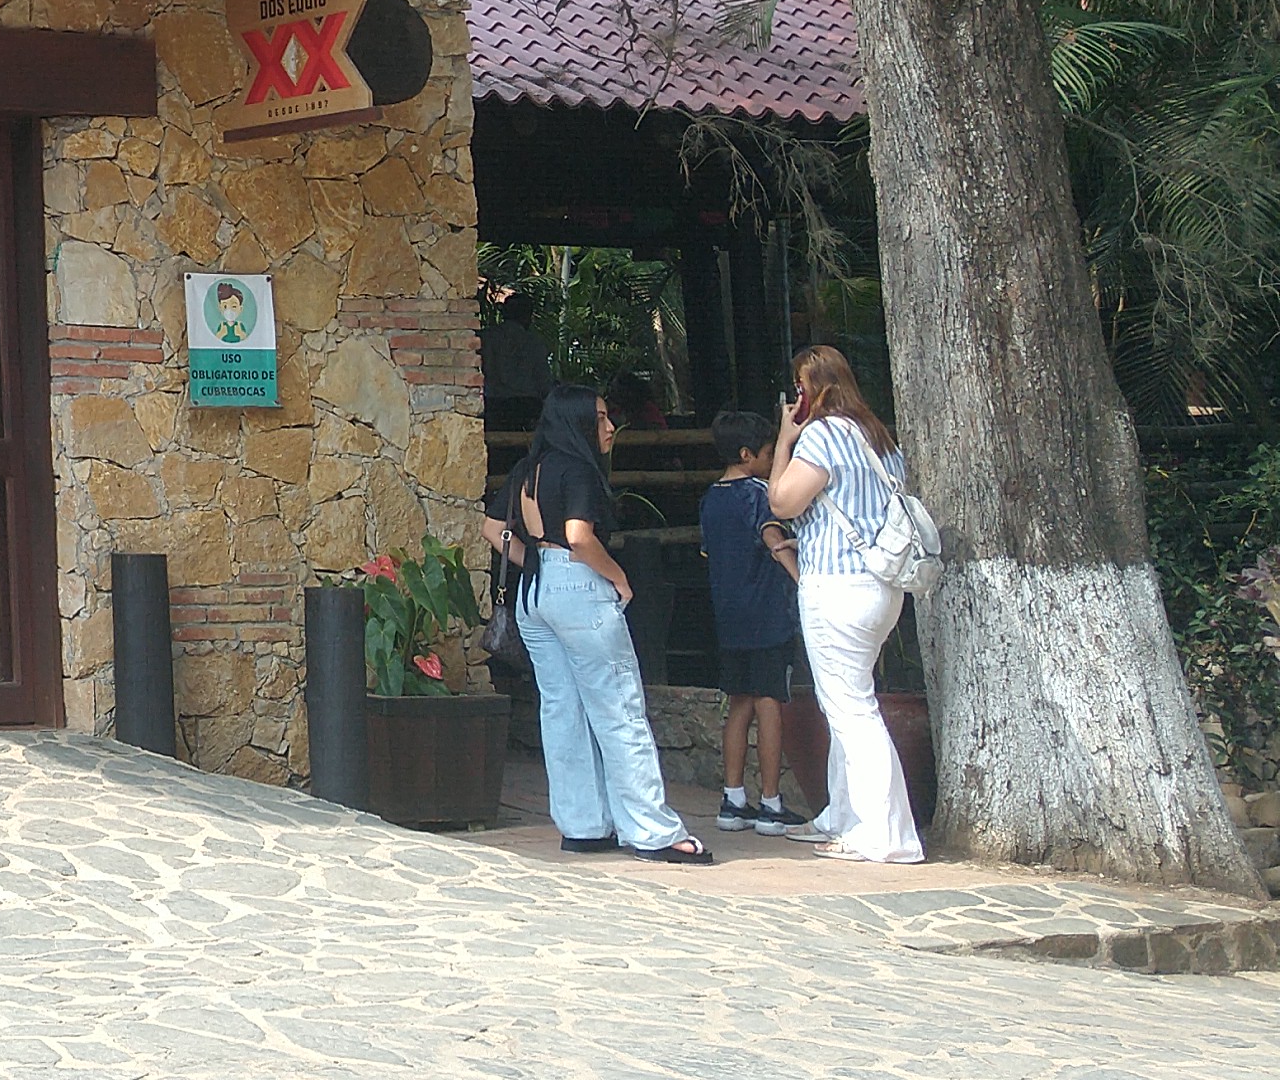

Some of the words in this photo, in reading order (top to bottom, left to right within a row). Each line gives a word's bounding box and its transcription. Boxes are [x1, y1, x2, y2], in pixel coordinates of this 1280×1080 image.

[241, 11, 351, 106] XX
[268, 104, 300, 118] DESDE
[305, 99, 329, 111] 1897
[221, 353, 242, 364] USO
[191, 370, 259, 380] OBLIGATORIO
[261, 370, 275, 380] DE
[201, 386, 266, 397] CUBREBOCAS
